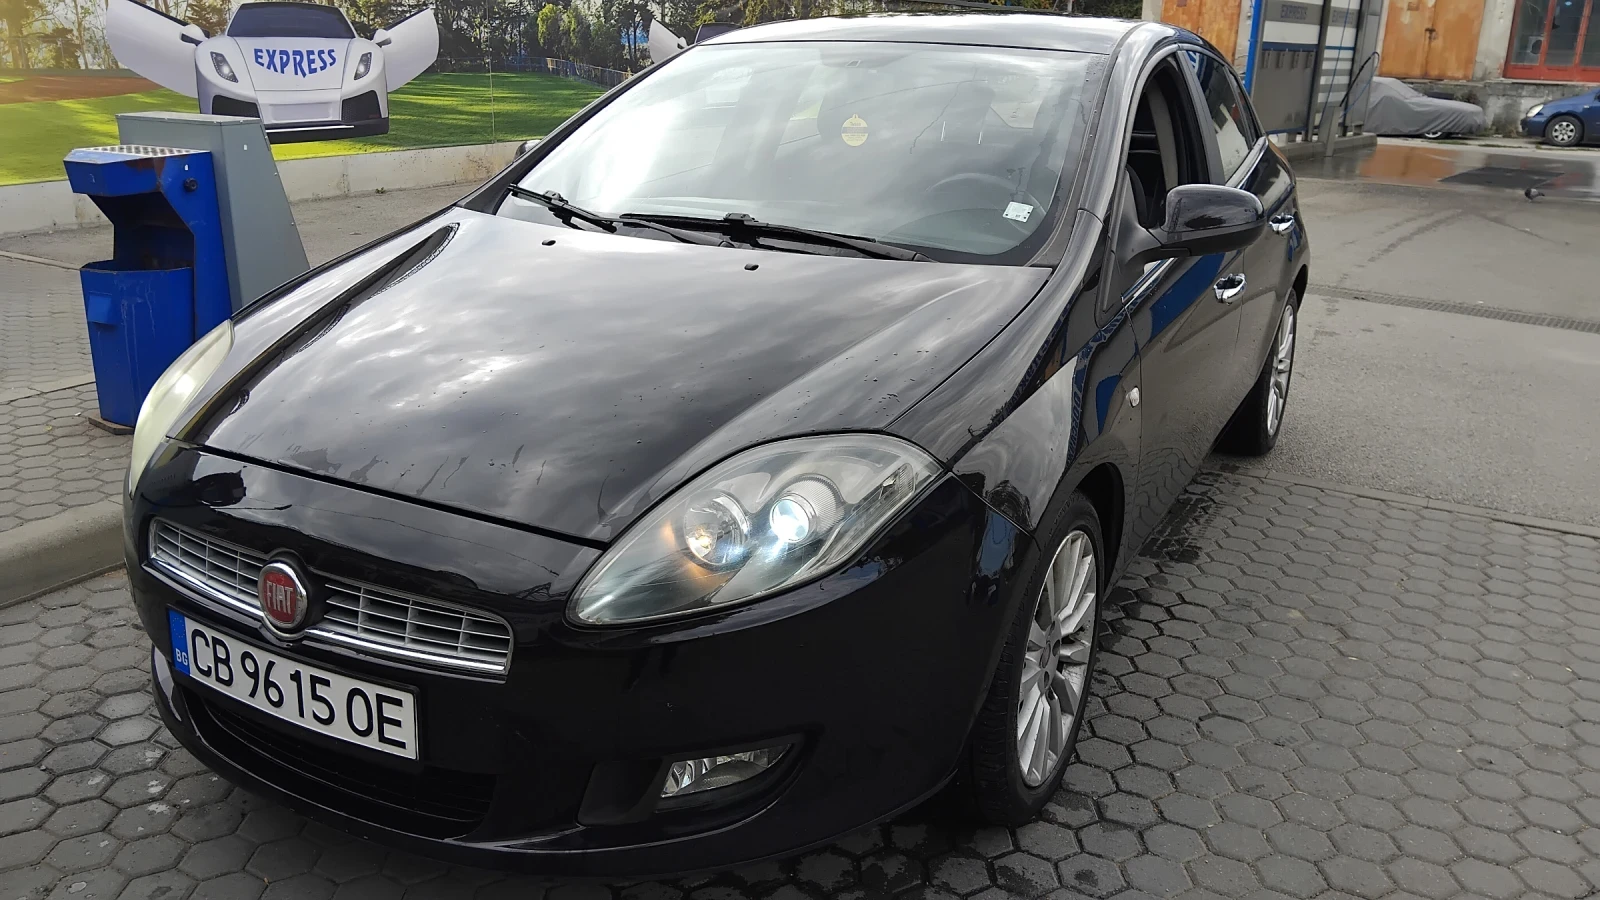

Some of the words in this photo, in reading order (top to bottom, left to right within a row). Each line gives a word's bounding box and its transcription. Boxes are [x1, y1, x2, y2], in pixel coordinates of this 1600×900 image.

[253, 48, 337, 78] EXPRESS
[266, 580, 294, 615] FIAT
[175, 648, 188, 666] BG
[191, 628, 235, 687] CB
[240, 651, 336, 726] 9615
[346, 687, 407, 750] OE
